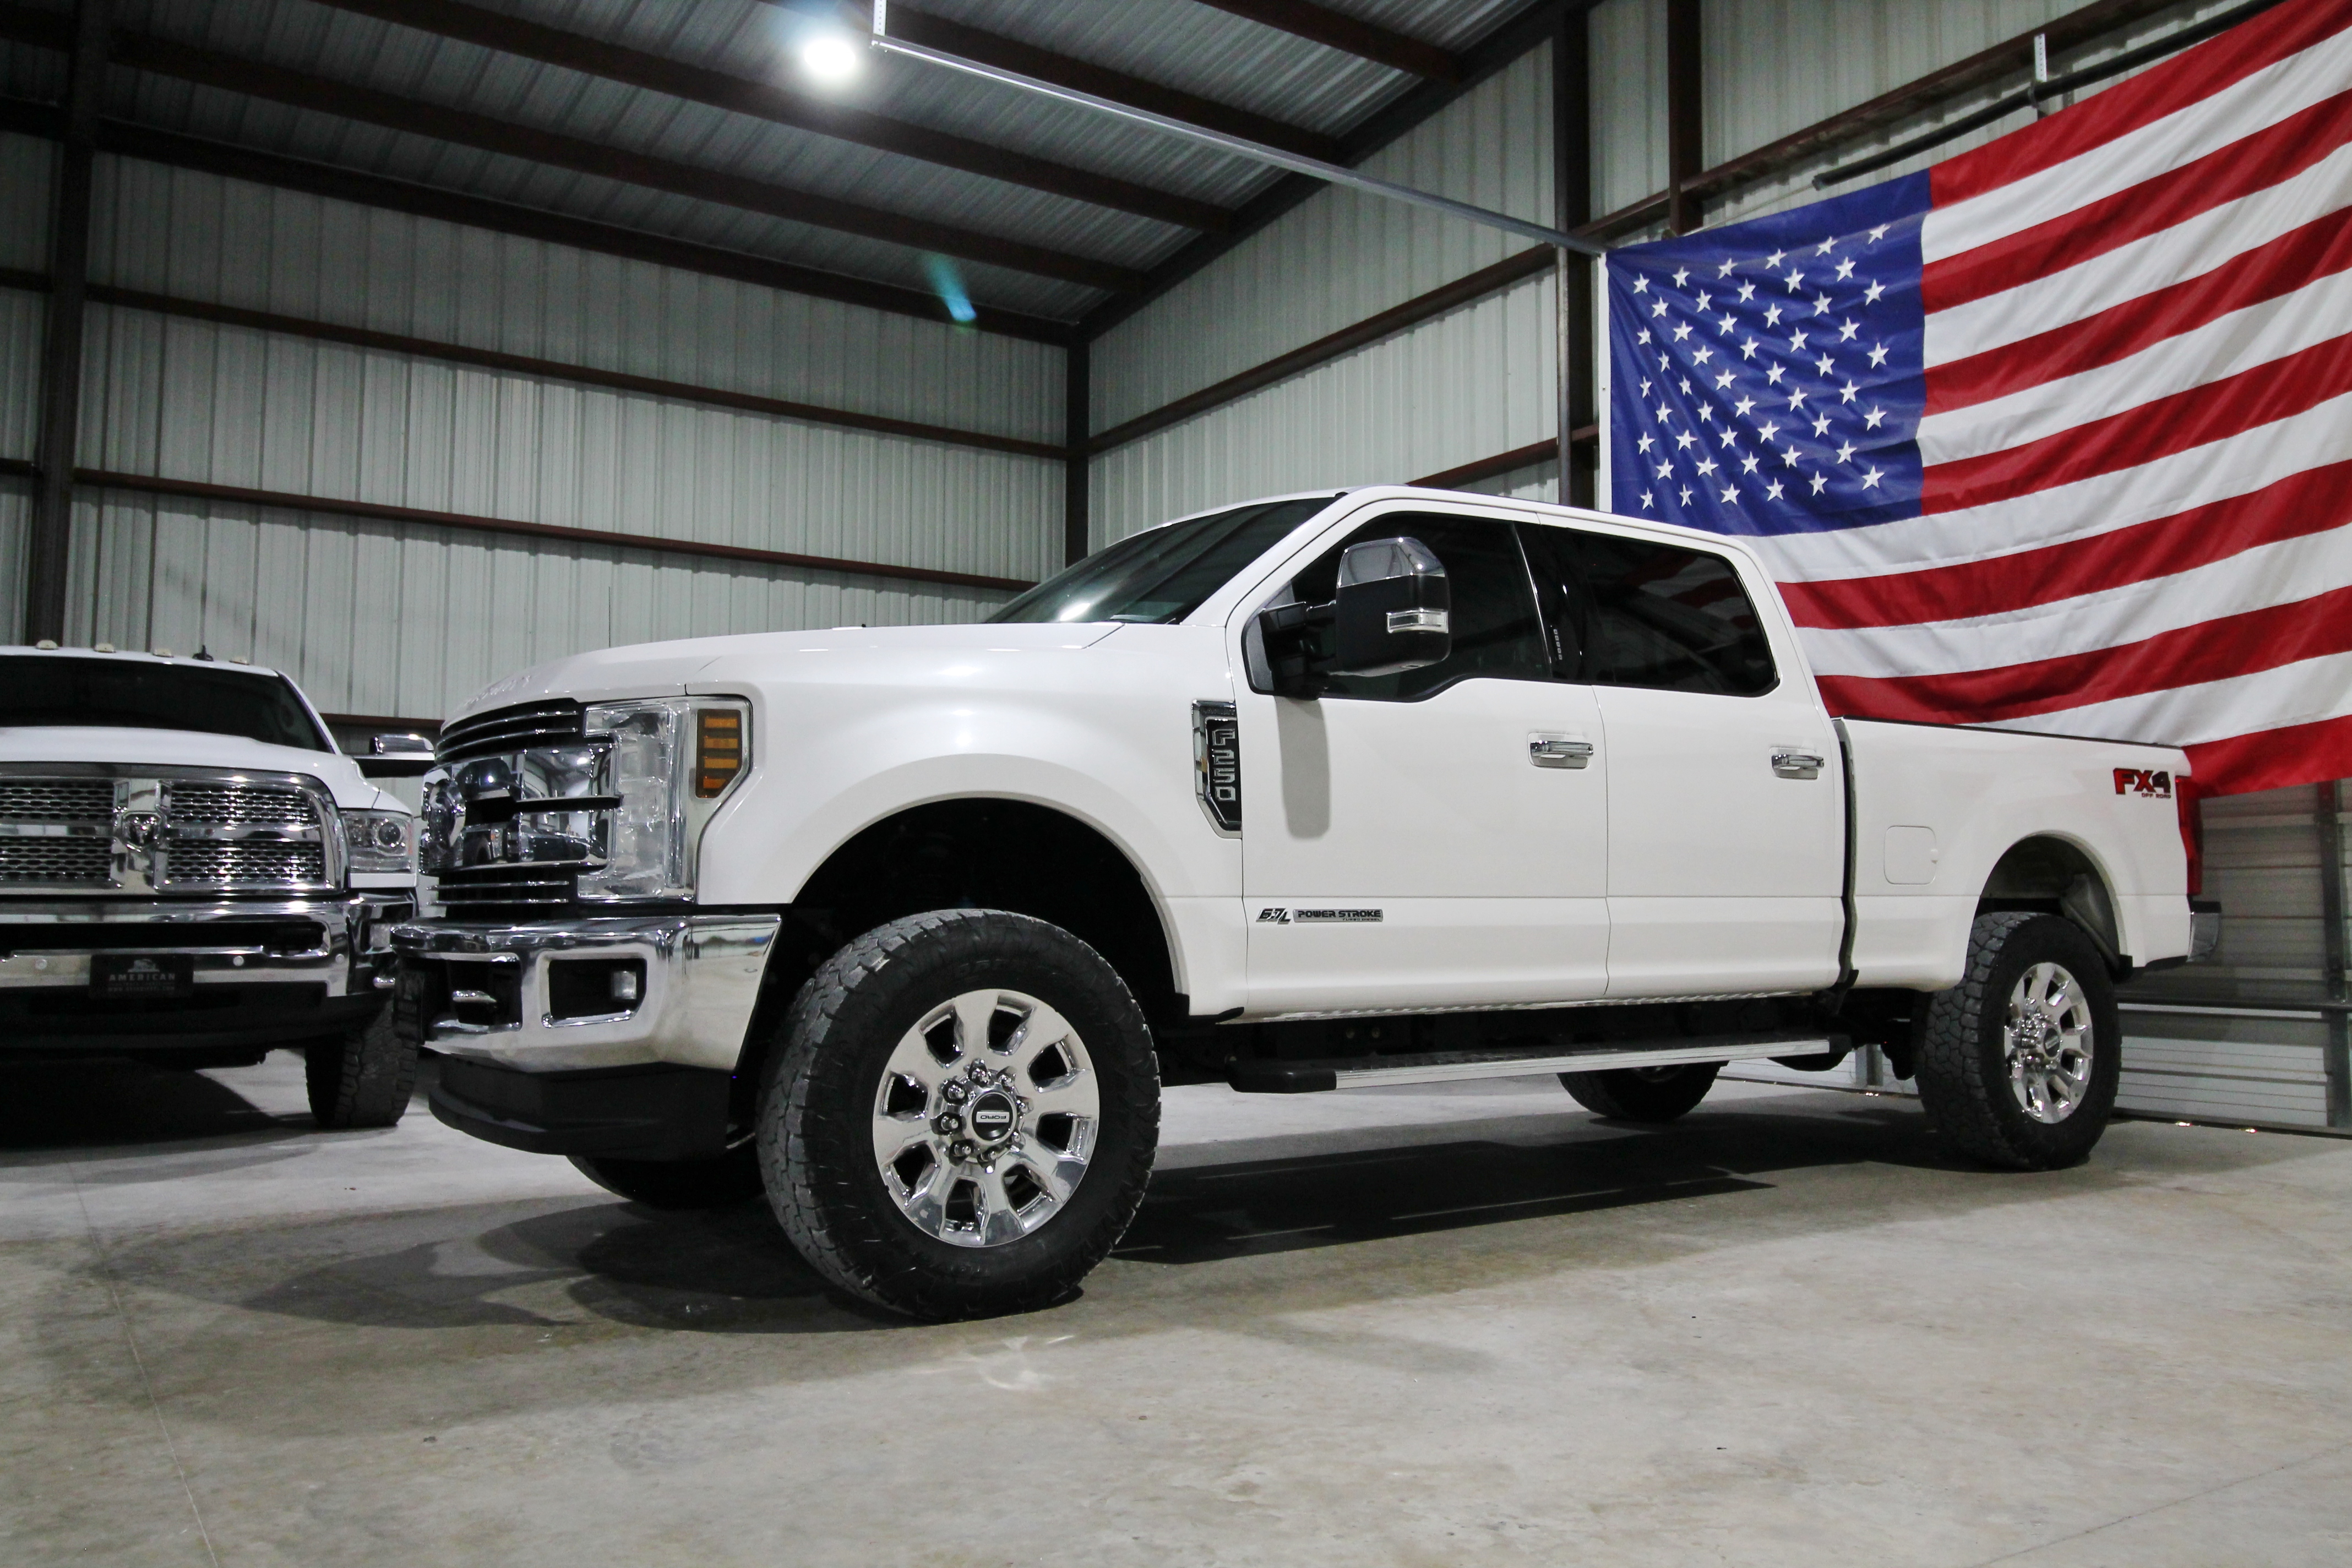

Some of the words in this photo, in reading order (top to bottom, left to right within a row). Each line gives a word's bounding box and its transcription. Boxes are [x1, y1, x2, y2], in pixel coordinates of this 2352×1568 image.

[2113, 767, 2171, 795] FX4
[1256, 908, 1292, 925] 6.7L
[108, 973, 176, 982] AMERICAN
